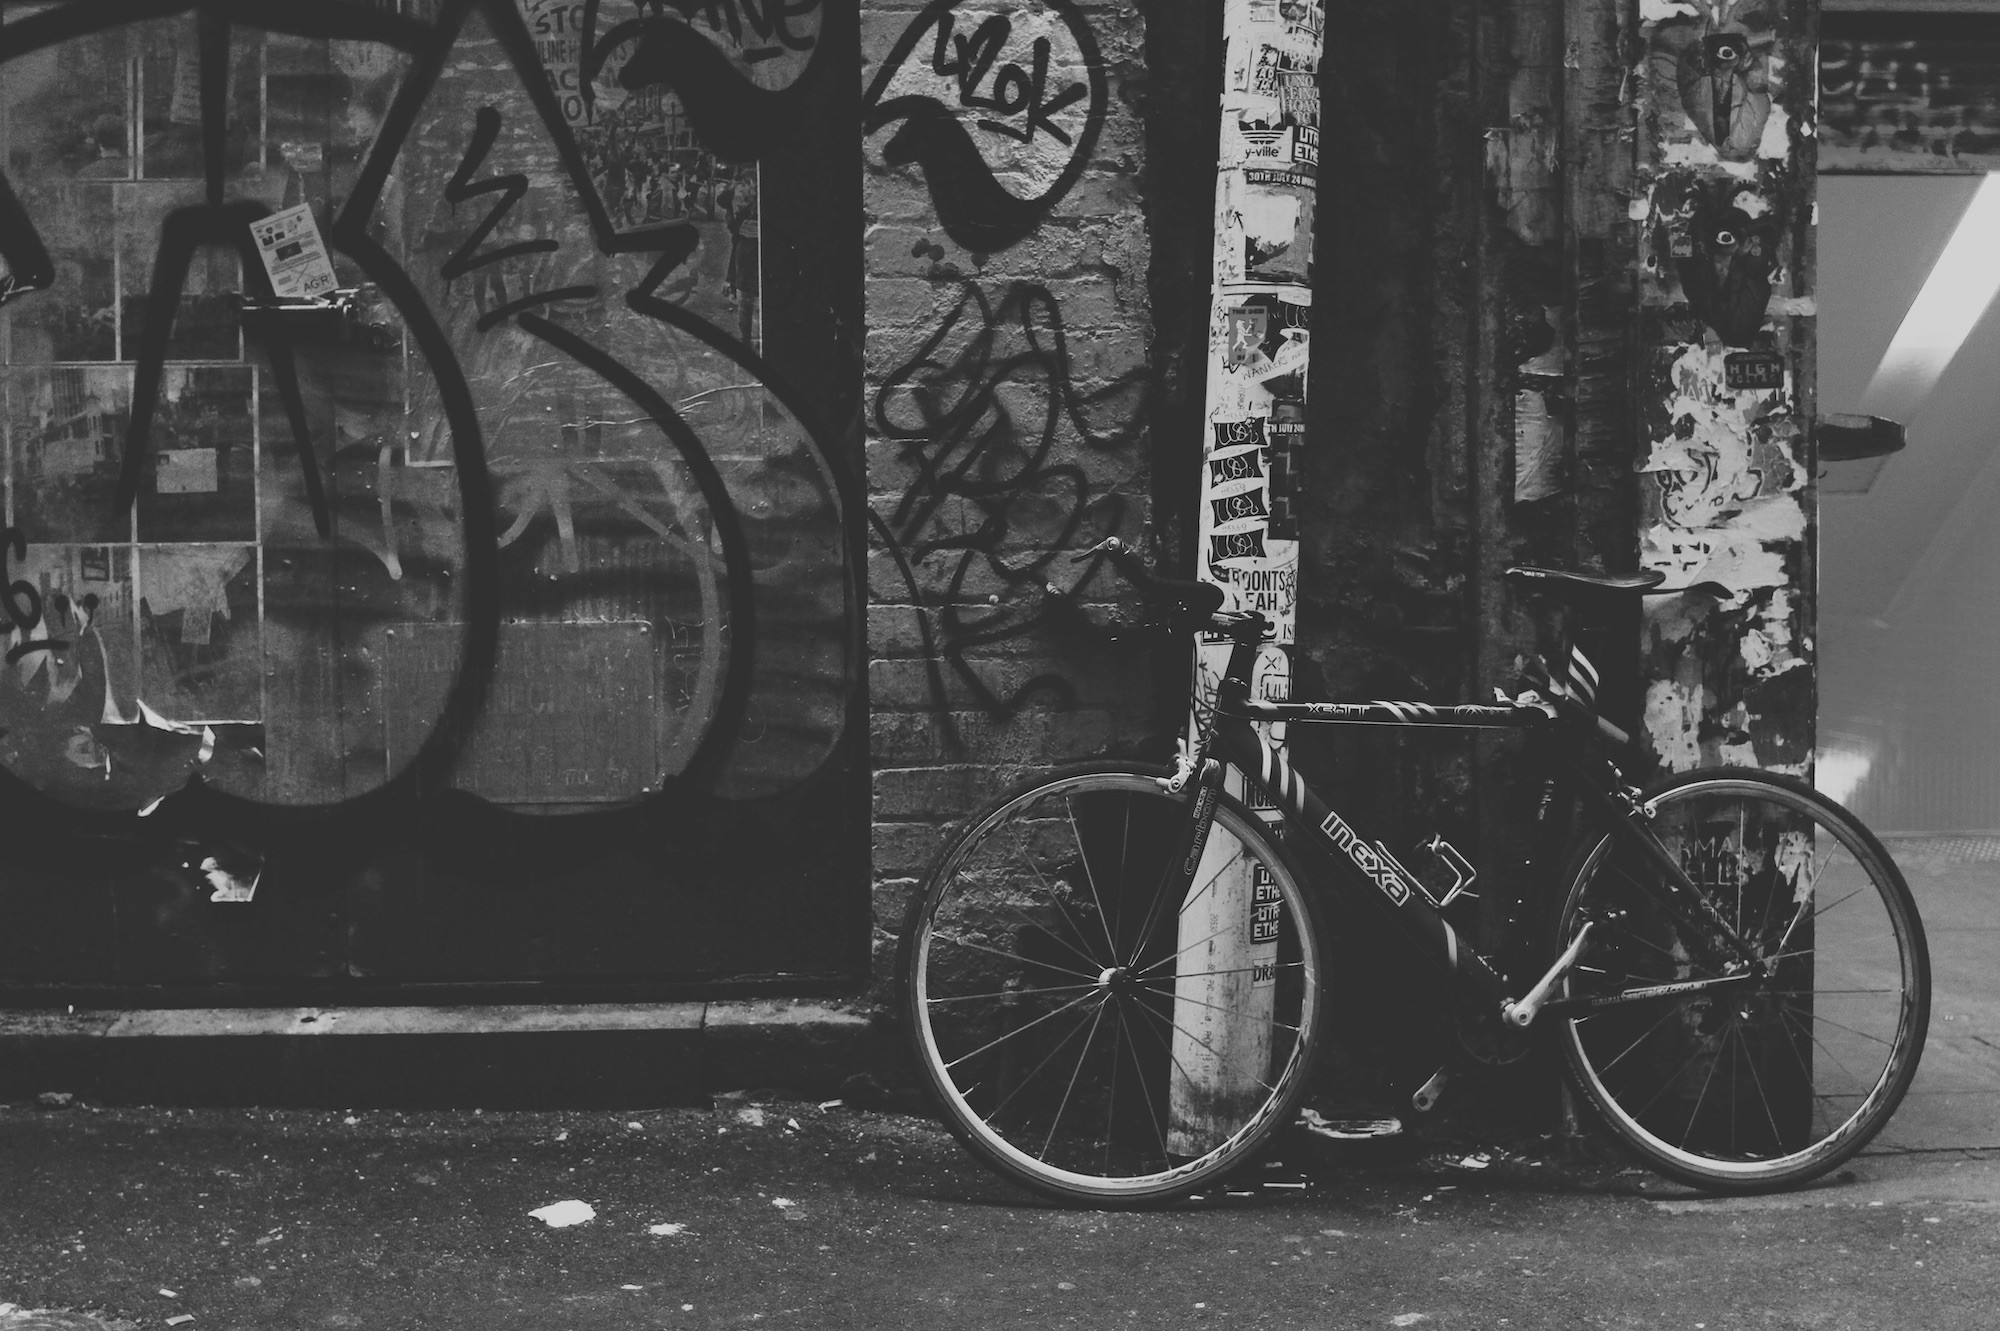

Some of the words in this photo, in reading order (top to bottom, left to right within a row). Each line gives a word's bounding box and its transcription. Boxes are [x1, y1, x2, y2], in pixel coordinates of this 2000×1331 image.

[1248, 171, 1271, 182] 30TH
[1272, 171, 1291, 183] JULY
[1729, 362, 1781, 375] HIGH
[1184, 788, 1217, 876] Carbon
